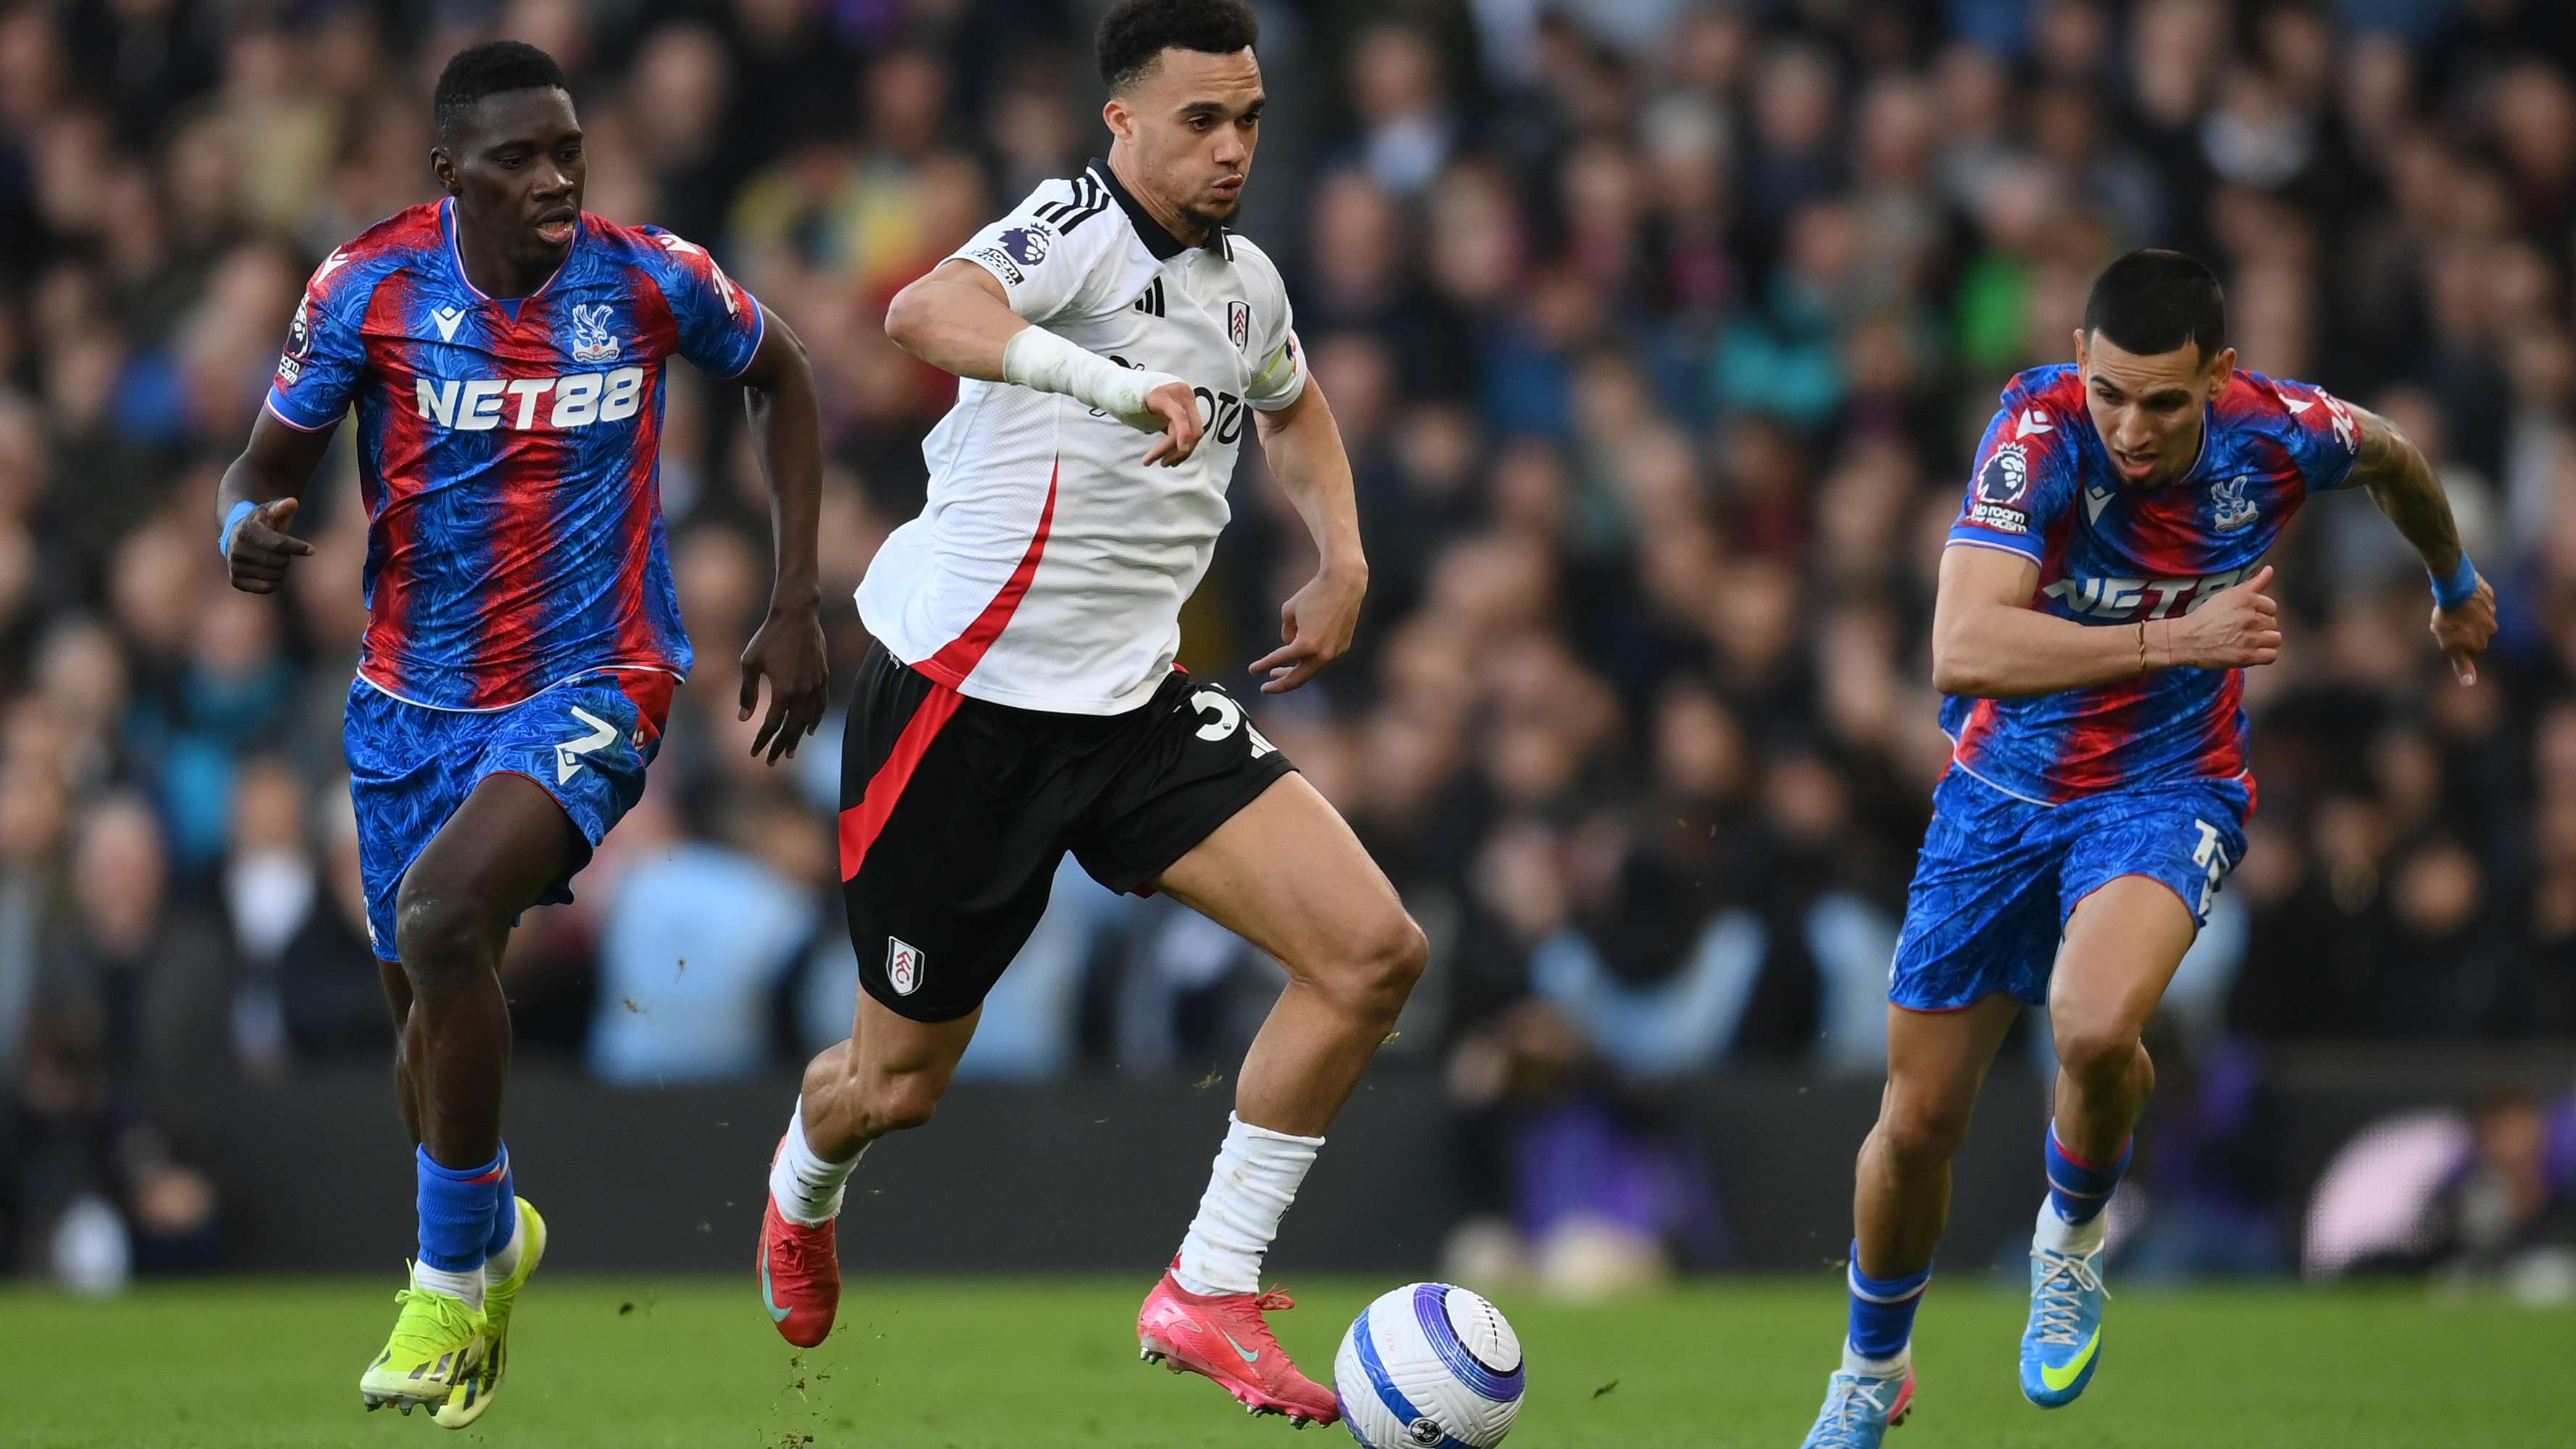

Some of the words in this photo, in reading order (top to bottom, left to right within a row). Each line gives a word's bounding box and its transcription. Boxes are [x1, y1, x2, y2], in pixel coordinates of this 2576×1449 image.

[416, 366, 643, 430] NET88
[1988, 505, 2026, 524] room
[2042, 564, 2257, 620] NET8
[554, 705, 618, 755] 7
[895, 950, 912, 985] FFC
